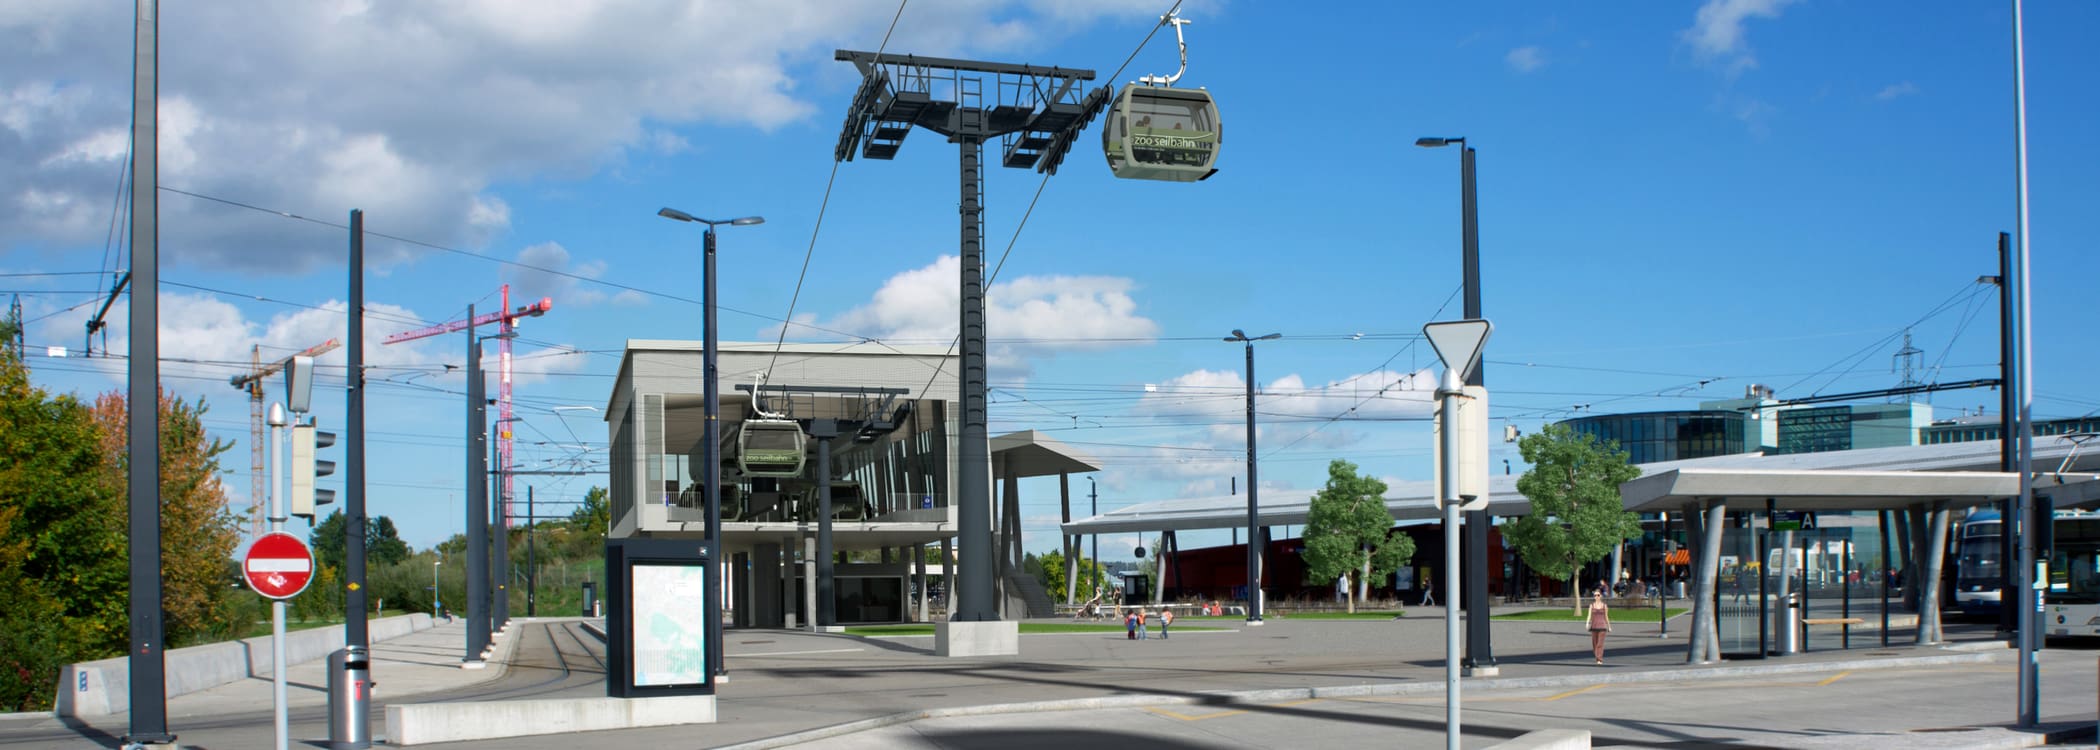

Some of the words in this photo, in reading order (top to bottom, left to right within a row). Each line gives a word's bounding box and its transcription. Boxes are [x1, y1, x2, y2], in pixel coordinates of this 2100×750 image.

[1134, 136, 1153, 145] zoo
[1155, 136, 1196, 148] seilbahn
[1801, 513, 1814, 529] A
